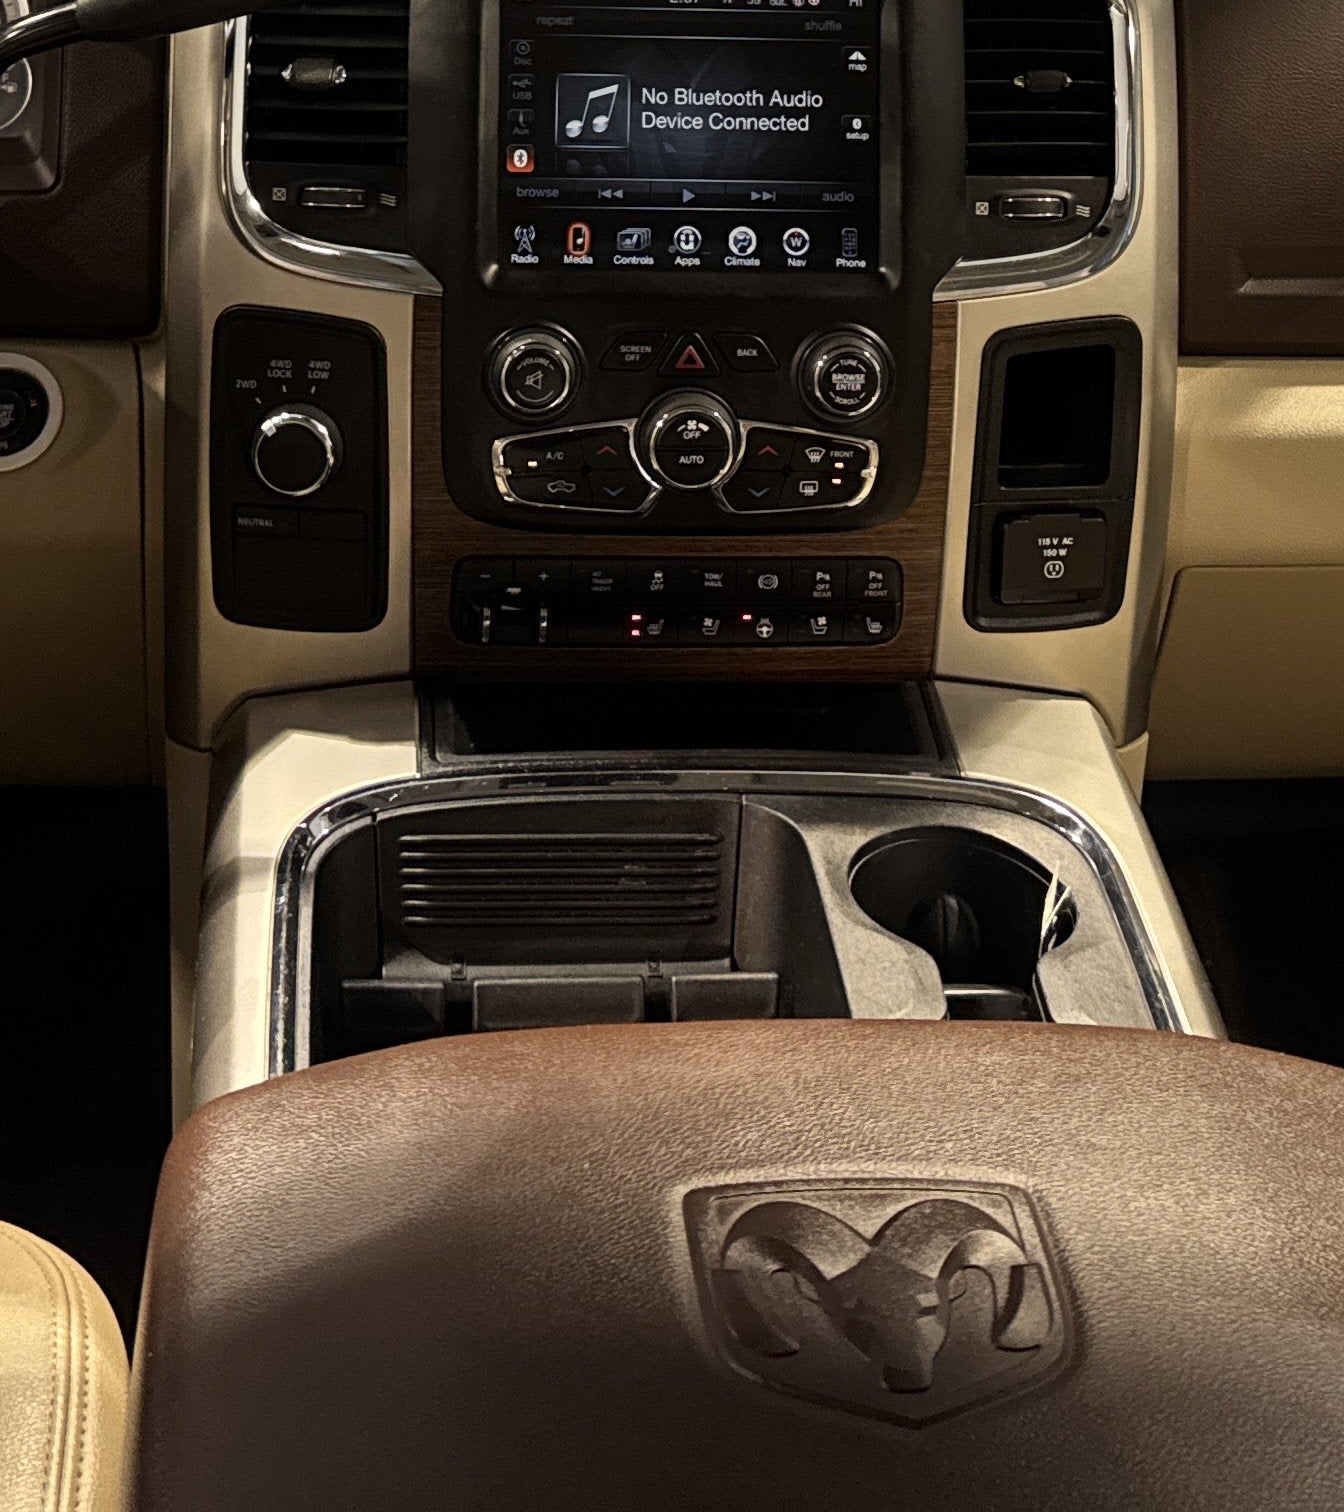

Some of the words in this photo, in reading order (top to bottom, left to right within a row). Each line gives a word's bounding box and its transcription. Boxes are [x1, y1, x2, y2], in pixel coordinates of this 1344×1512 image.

[536, 15, 575, 28] repeat
[804, 19, 843, 32] shuffle
[513, 56, 533, 66] Disc
[847, 63, 868, 72] map
[512, 90, 533, 101] USB
[641, 87, 668, 106] No
[674, 88, 764, 106] Bluetooth
[769, 90, 824, 108] Audio
[641, 112, 704, 130] Device
[708, 114, 810, 132] Connected
[512, 126, 531, 136] Aux
[845, 130, 870, 141] setup
[516, 186, 560, 198] browse
[821, 190, 855, 203] audio
[510, 253, 539, 264] Radio
[563, 254, 593, 265] Media
[613, 255, 654, 266] Controls
[674, 256, 701, 267] Apps
[724, 256, 761, 267] Climate
[787, 257, 807, 267] Nav
[835, 258, 867, 269] Phone
[619, 344, 652, 354] SCREEN
[736, 348, 758, 357] BACK
[521, 357, 550, 368] VOLUME
[625, 353, 641, 362] OFF
[269, 359, 293, 369] 4WD
[307, 360, 332, 370] 4WD
[839, 359, 859, 367] TUNE
[267, 369, 293, 379] LOCK
[307, 370, 330, 380] LOW
[831, 373, 866, 383] BROWSE
[235, 379, 258, 389] 2WD
[835, 382, 862, 392] ENTER
[834, 395, 860, 406] SCROLL
[682, 431, 702, 440] OFF
[545, 451, 565, 461] A/C
[678, 455, 705, 464] AUTO
[829, 450, 855, 459] FRONT
[237, 517, 274, 528] NEUTRAL
[1061, 537, 1074, 546] AC
[1058, 548, 1068, 556] W
[704, 572, 724, 581] TOW/
[649, 581, 665, 591] OFF
[703, 580, 723, 588] HAUL
[815, 583, 831, 591] OFF
[867, 582, 883, 590] OFF
[812, 590, 832, 598] REAR
[863, 589, 889, 598] FRONT
